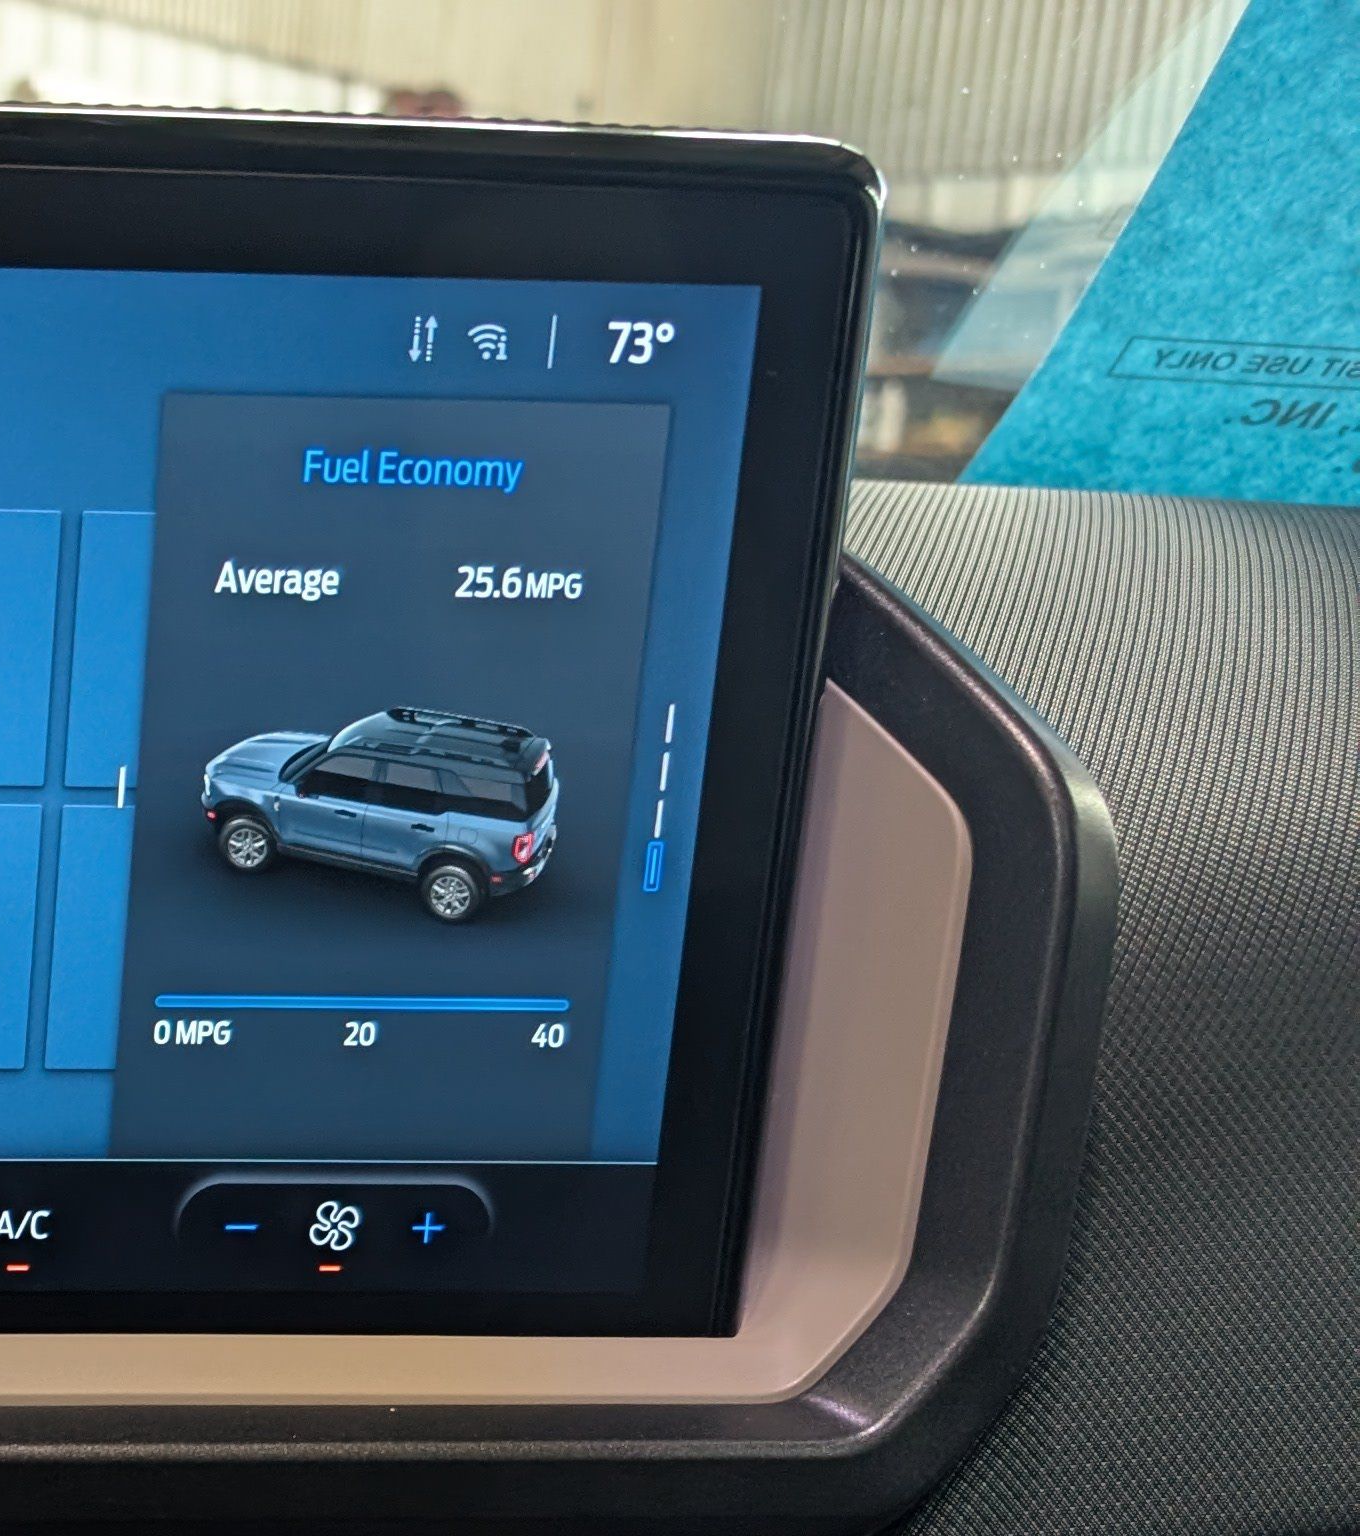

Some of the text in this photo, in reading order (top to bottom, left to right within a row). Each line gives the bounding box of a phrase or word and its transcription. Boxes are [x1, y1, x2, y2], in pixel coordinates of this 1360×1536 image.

[302, 449, 524, 494] Fuel Economy
[213, 560, 342, 604] Average
[153, 1019, 233, 1046] 0 MPG
[343, 1021, 378, 1048] 20
[529, 1022, 567, 1049] 40
